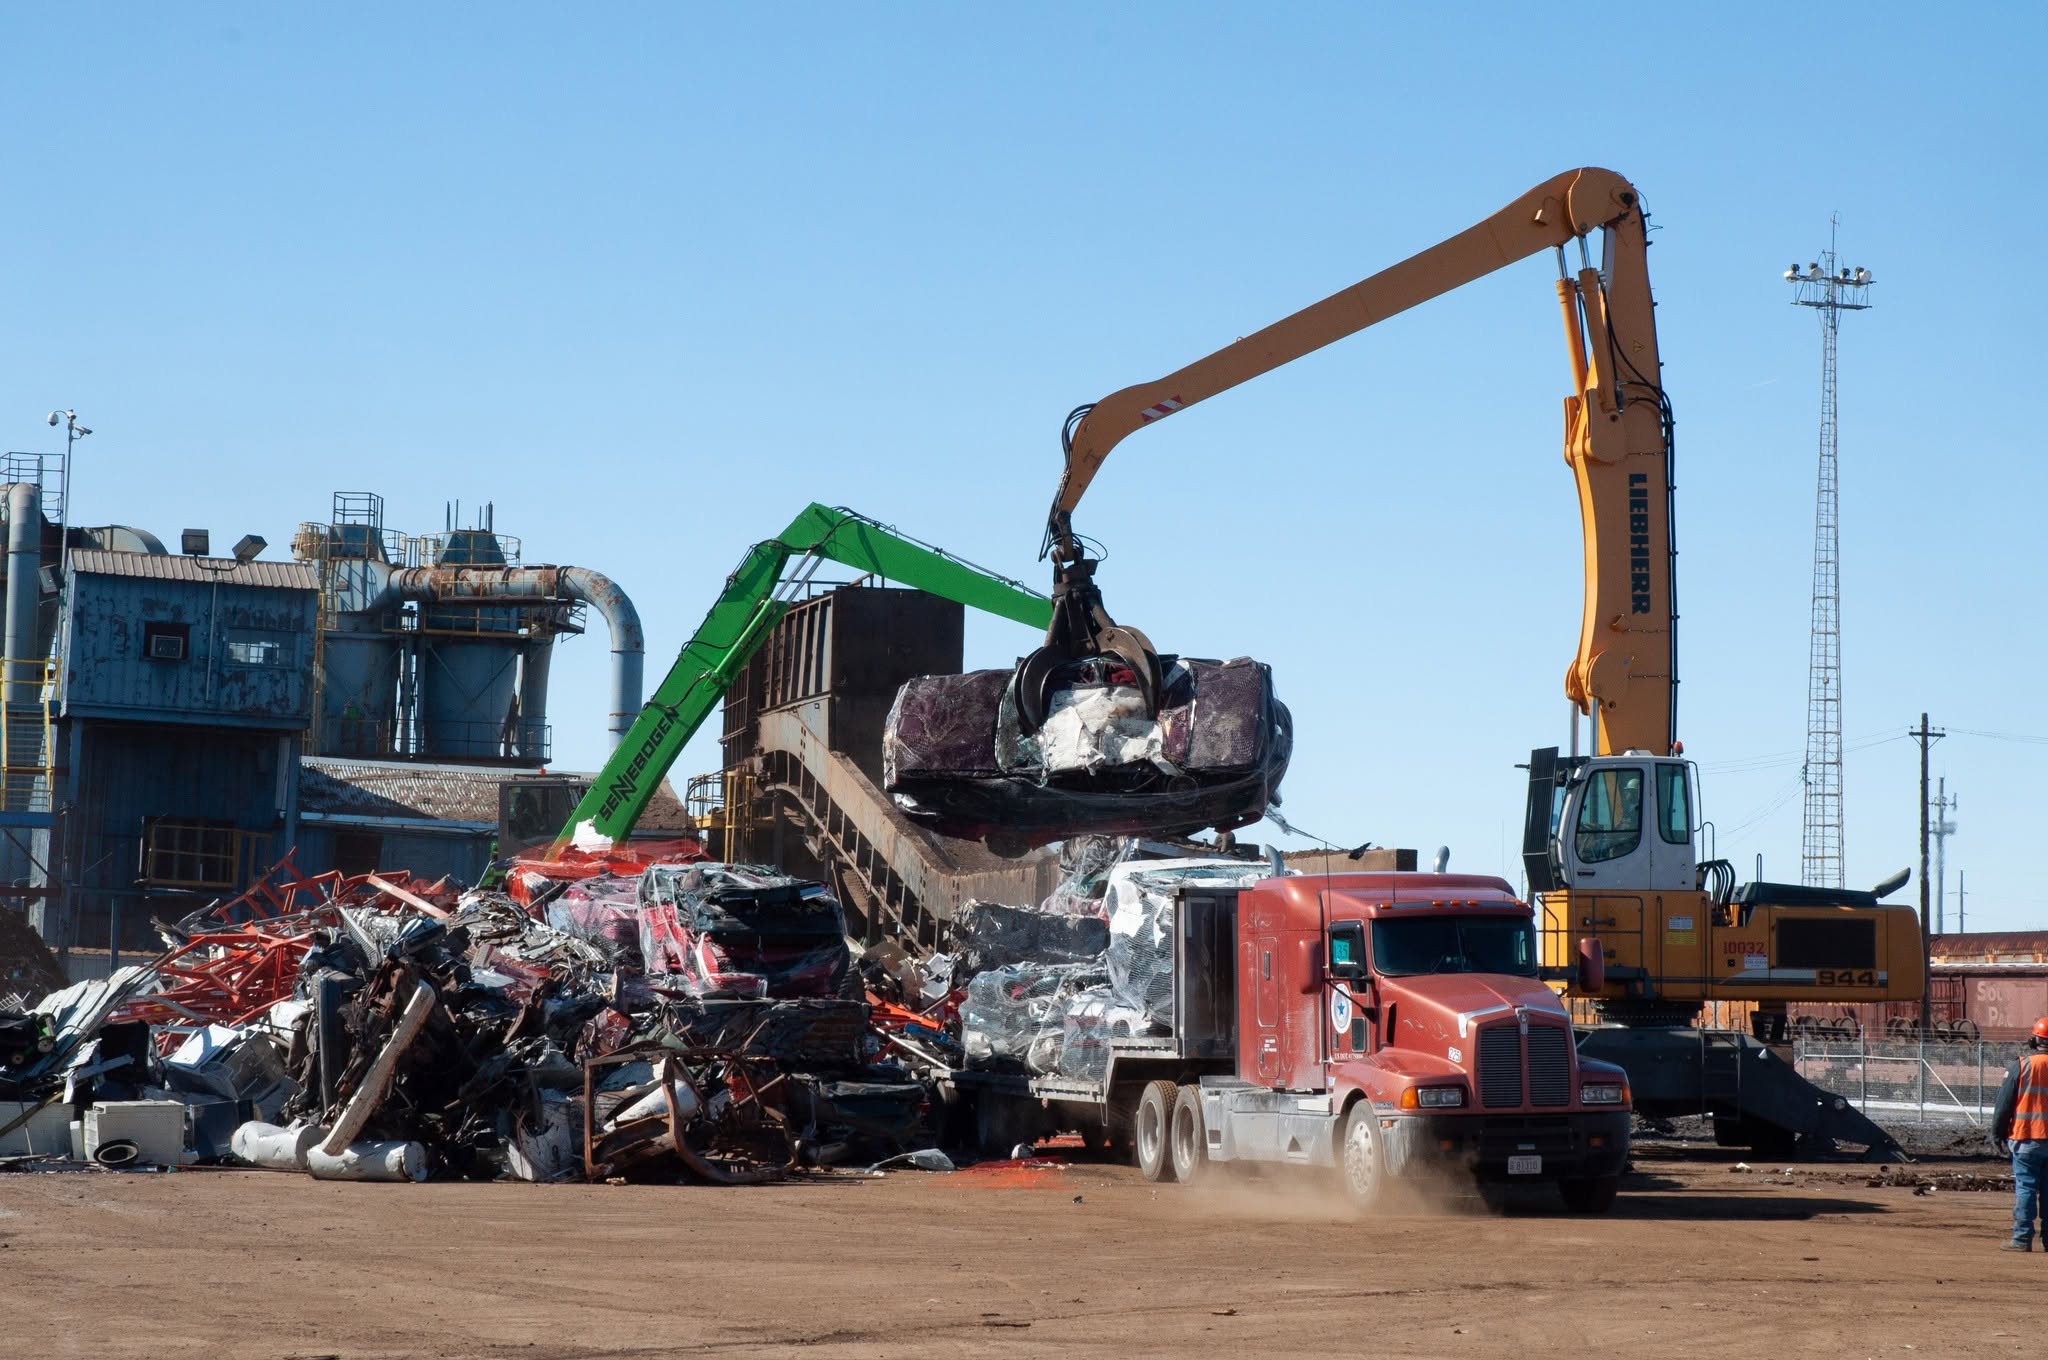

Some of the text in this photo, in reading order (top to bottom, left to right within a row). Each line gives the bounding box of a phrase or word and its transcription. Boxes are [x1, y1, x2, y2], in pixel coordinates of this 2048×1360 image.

[1629, 473, 1651, 615] LIEBHERR
[599, 708, 679, 821] SENNEBOGEN
[1723, 941, 1765, 955] 10032
[1819, 970, 1875, 986] 944
